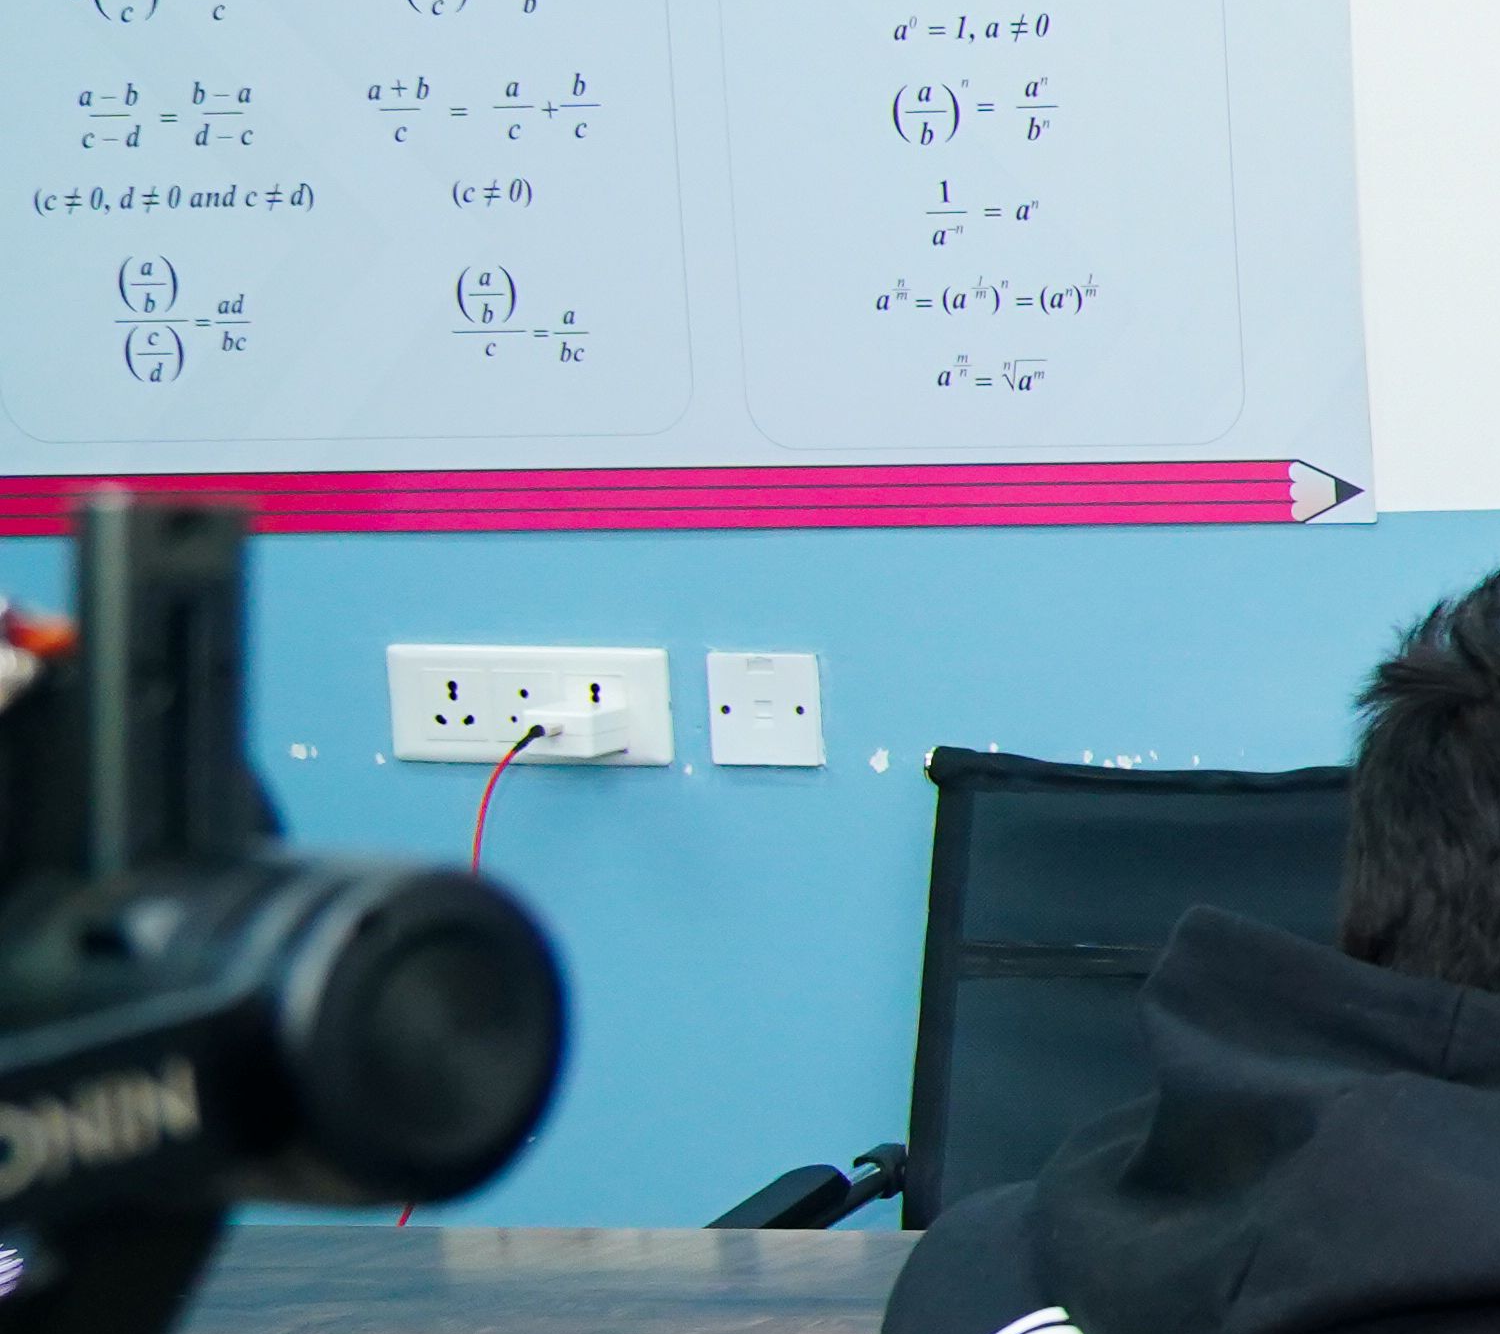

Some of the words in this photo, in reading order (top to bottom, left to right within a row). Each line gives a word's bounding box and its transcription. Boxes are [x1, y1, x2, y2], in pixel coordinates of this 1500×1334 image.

[1034, 12, 1051, 39] 0
[166, 184, 182, 210] 0
[188, 183, 238, 209] and
